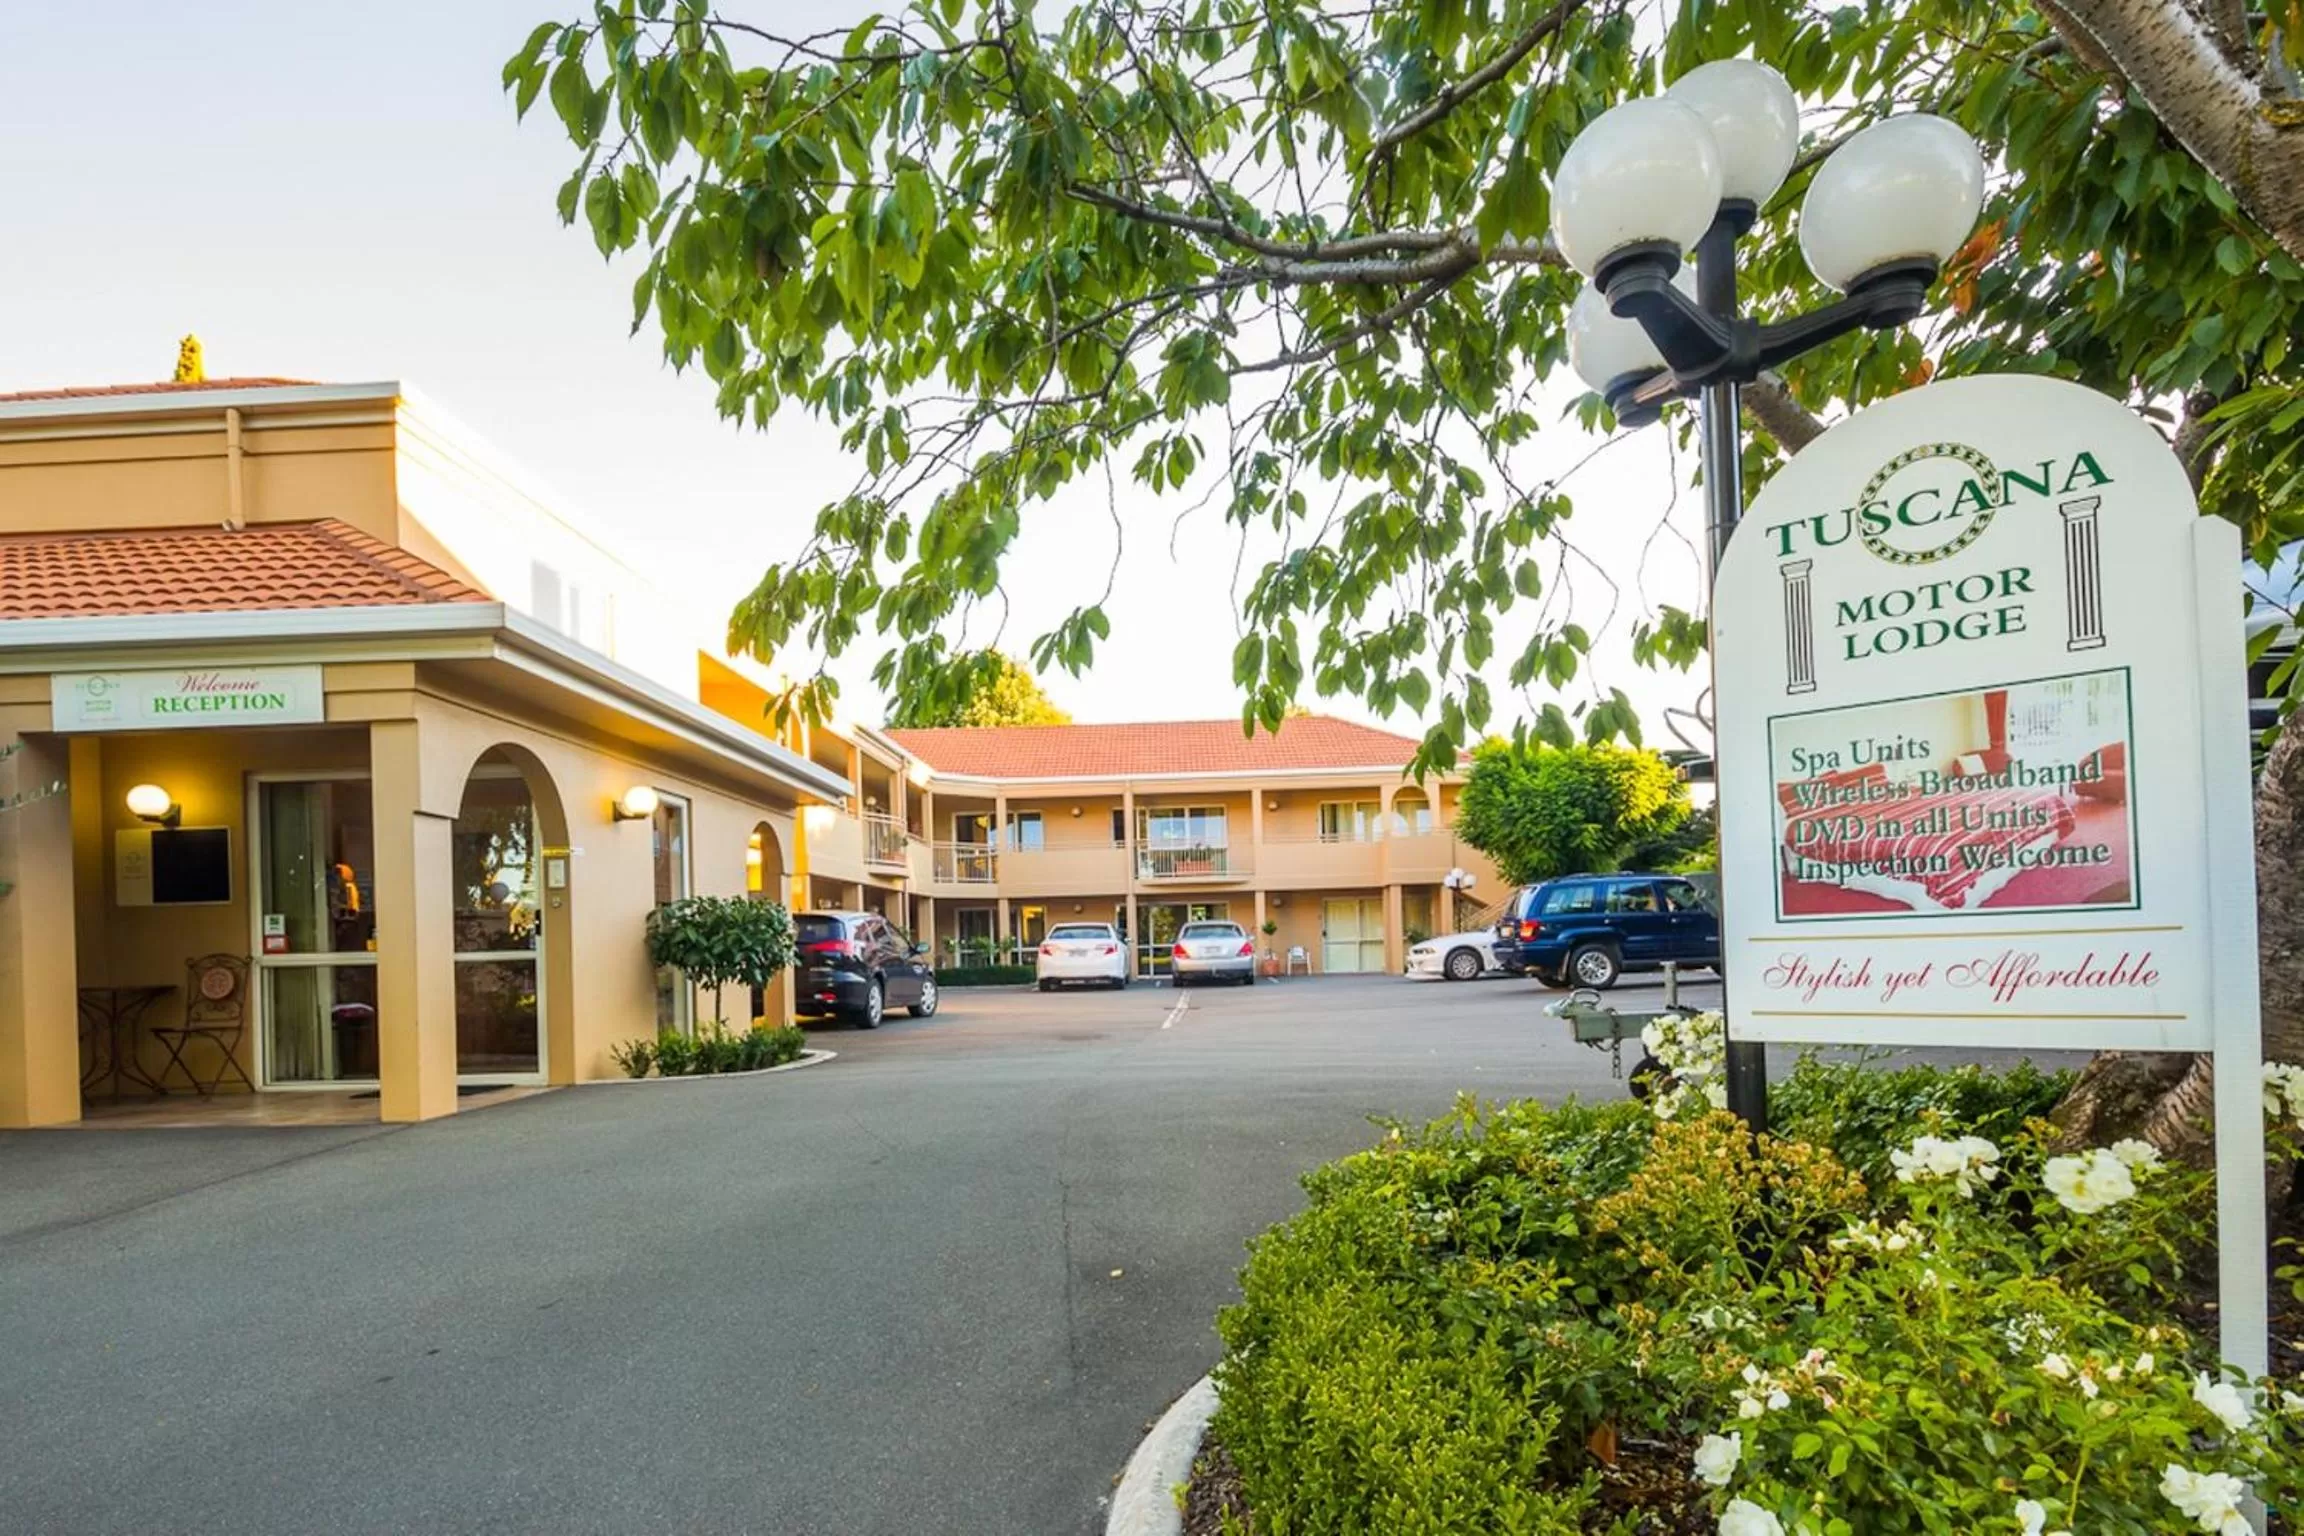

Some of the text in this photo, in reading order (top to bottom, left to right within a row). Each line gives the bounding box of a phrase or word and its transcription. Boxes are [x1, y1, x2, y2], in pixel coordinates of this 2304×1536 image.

[1765, 451, 2114, 558] TUSCANA
[1834, 566, 2036, 628] MOTOR
[1843, 604, 2028, 661] LODGE
[154, 693, 285, 713] RECEPTION
[176, 671, 260, 692] Welcome
[1791, 734, 1931, 778] Spa Units
[1794, 751, 2104, 809] Wireless Broadband
[1794, 800, 2049, 846] DVD in all Units
[1795, 841, 2113, 886] Inspection Welcome
[1763, 948, 2161, 1004] Stylish yet Affordable
